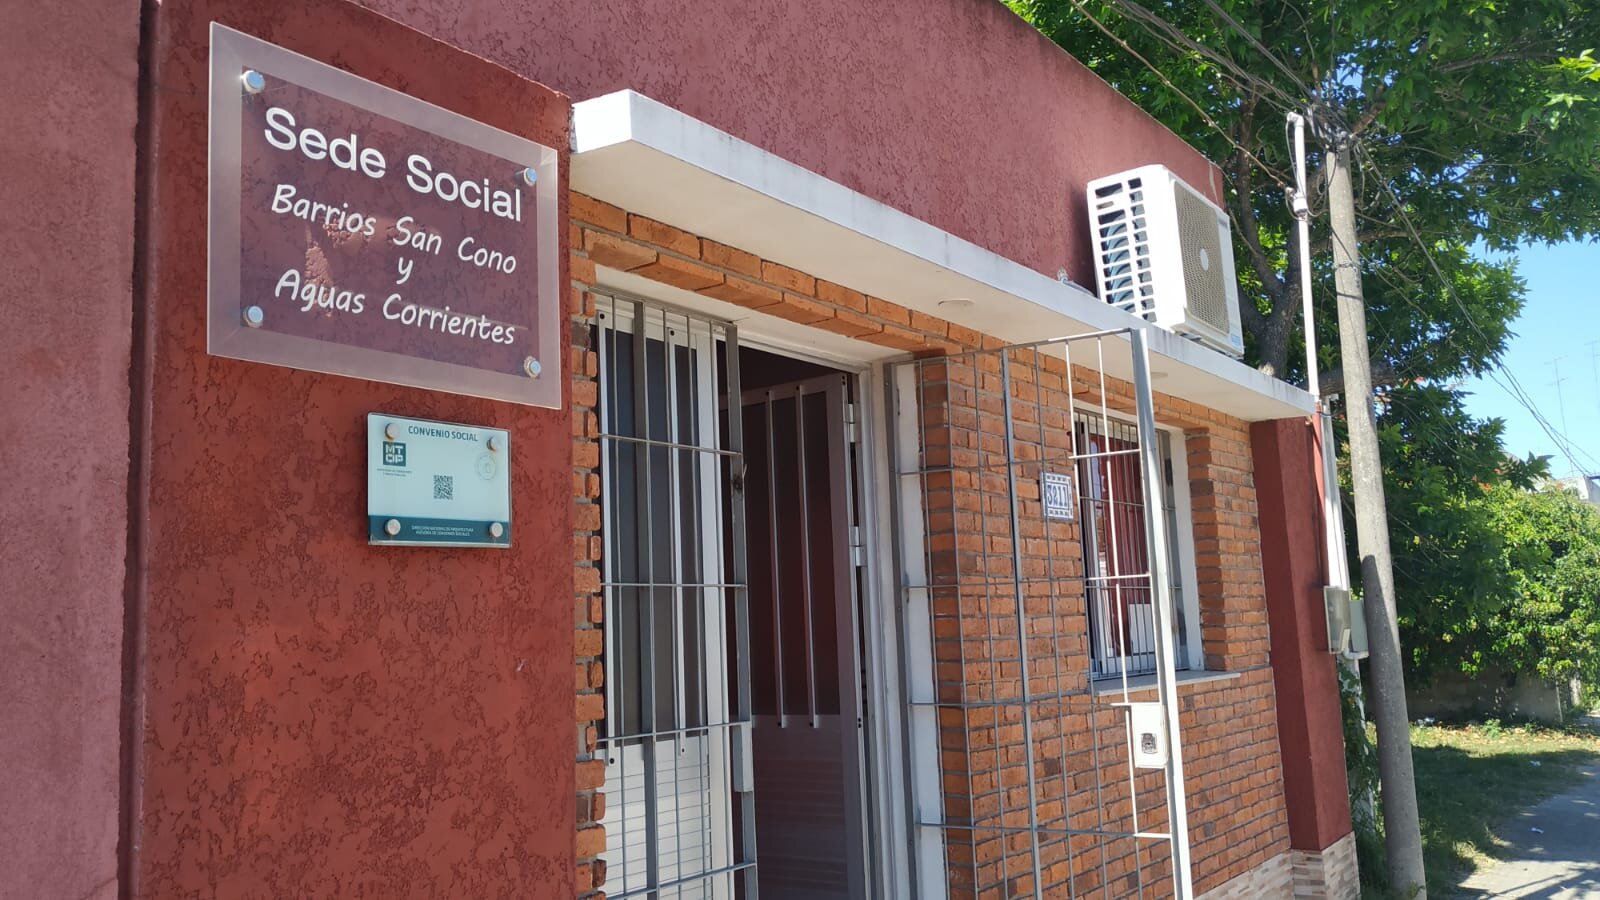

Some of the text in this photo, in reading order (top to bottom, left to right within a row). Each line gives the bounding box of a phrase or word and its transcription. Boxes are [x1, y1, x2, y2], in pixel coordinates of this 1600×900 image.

[264, 107, 522, 222] Sede Social
[271, 184, 517, 274] Barrios San Cono
[274, 269, 516, 345] Aguas Corrientes
[397, 256, 414, 285] y
[408, 425, 479, 442] CONVENIO SOCIAL
